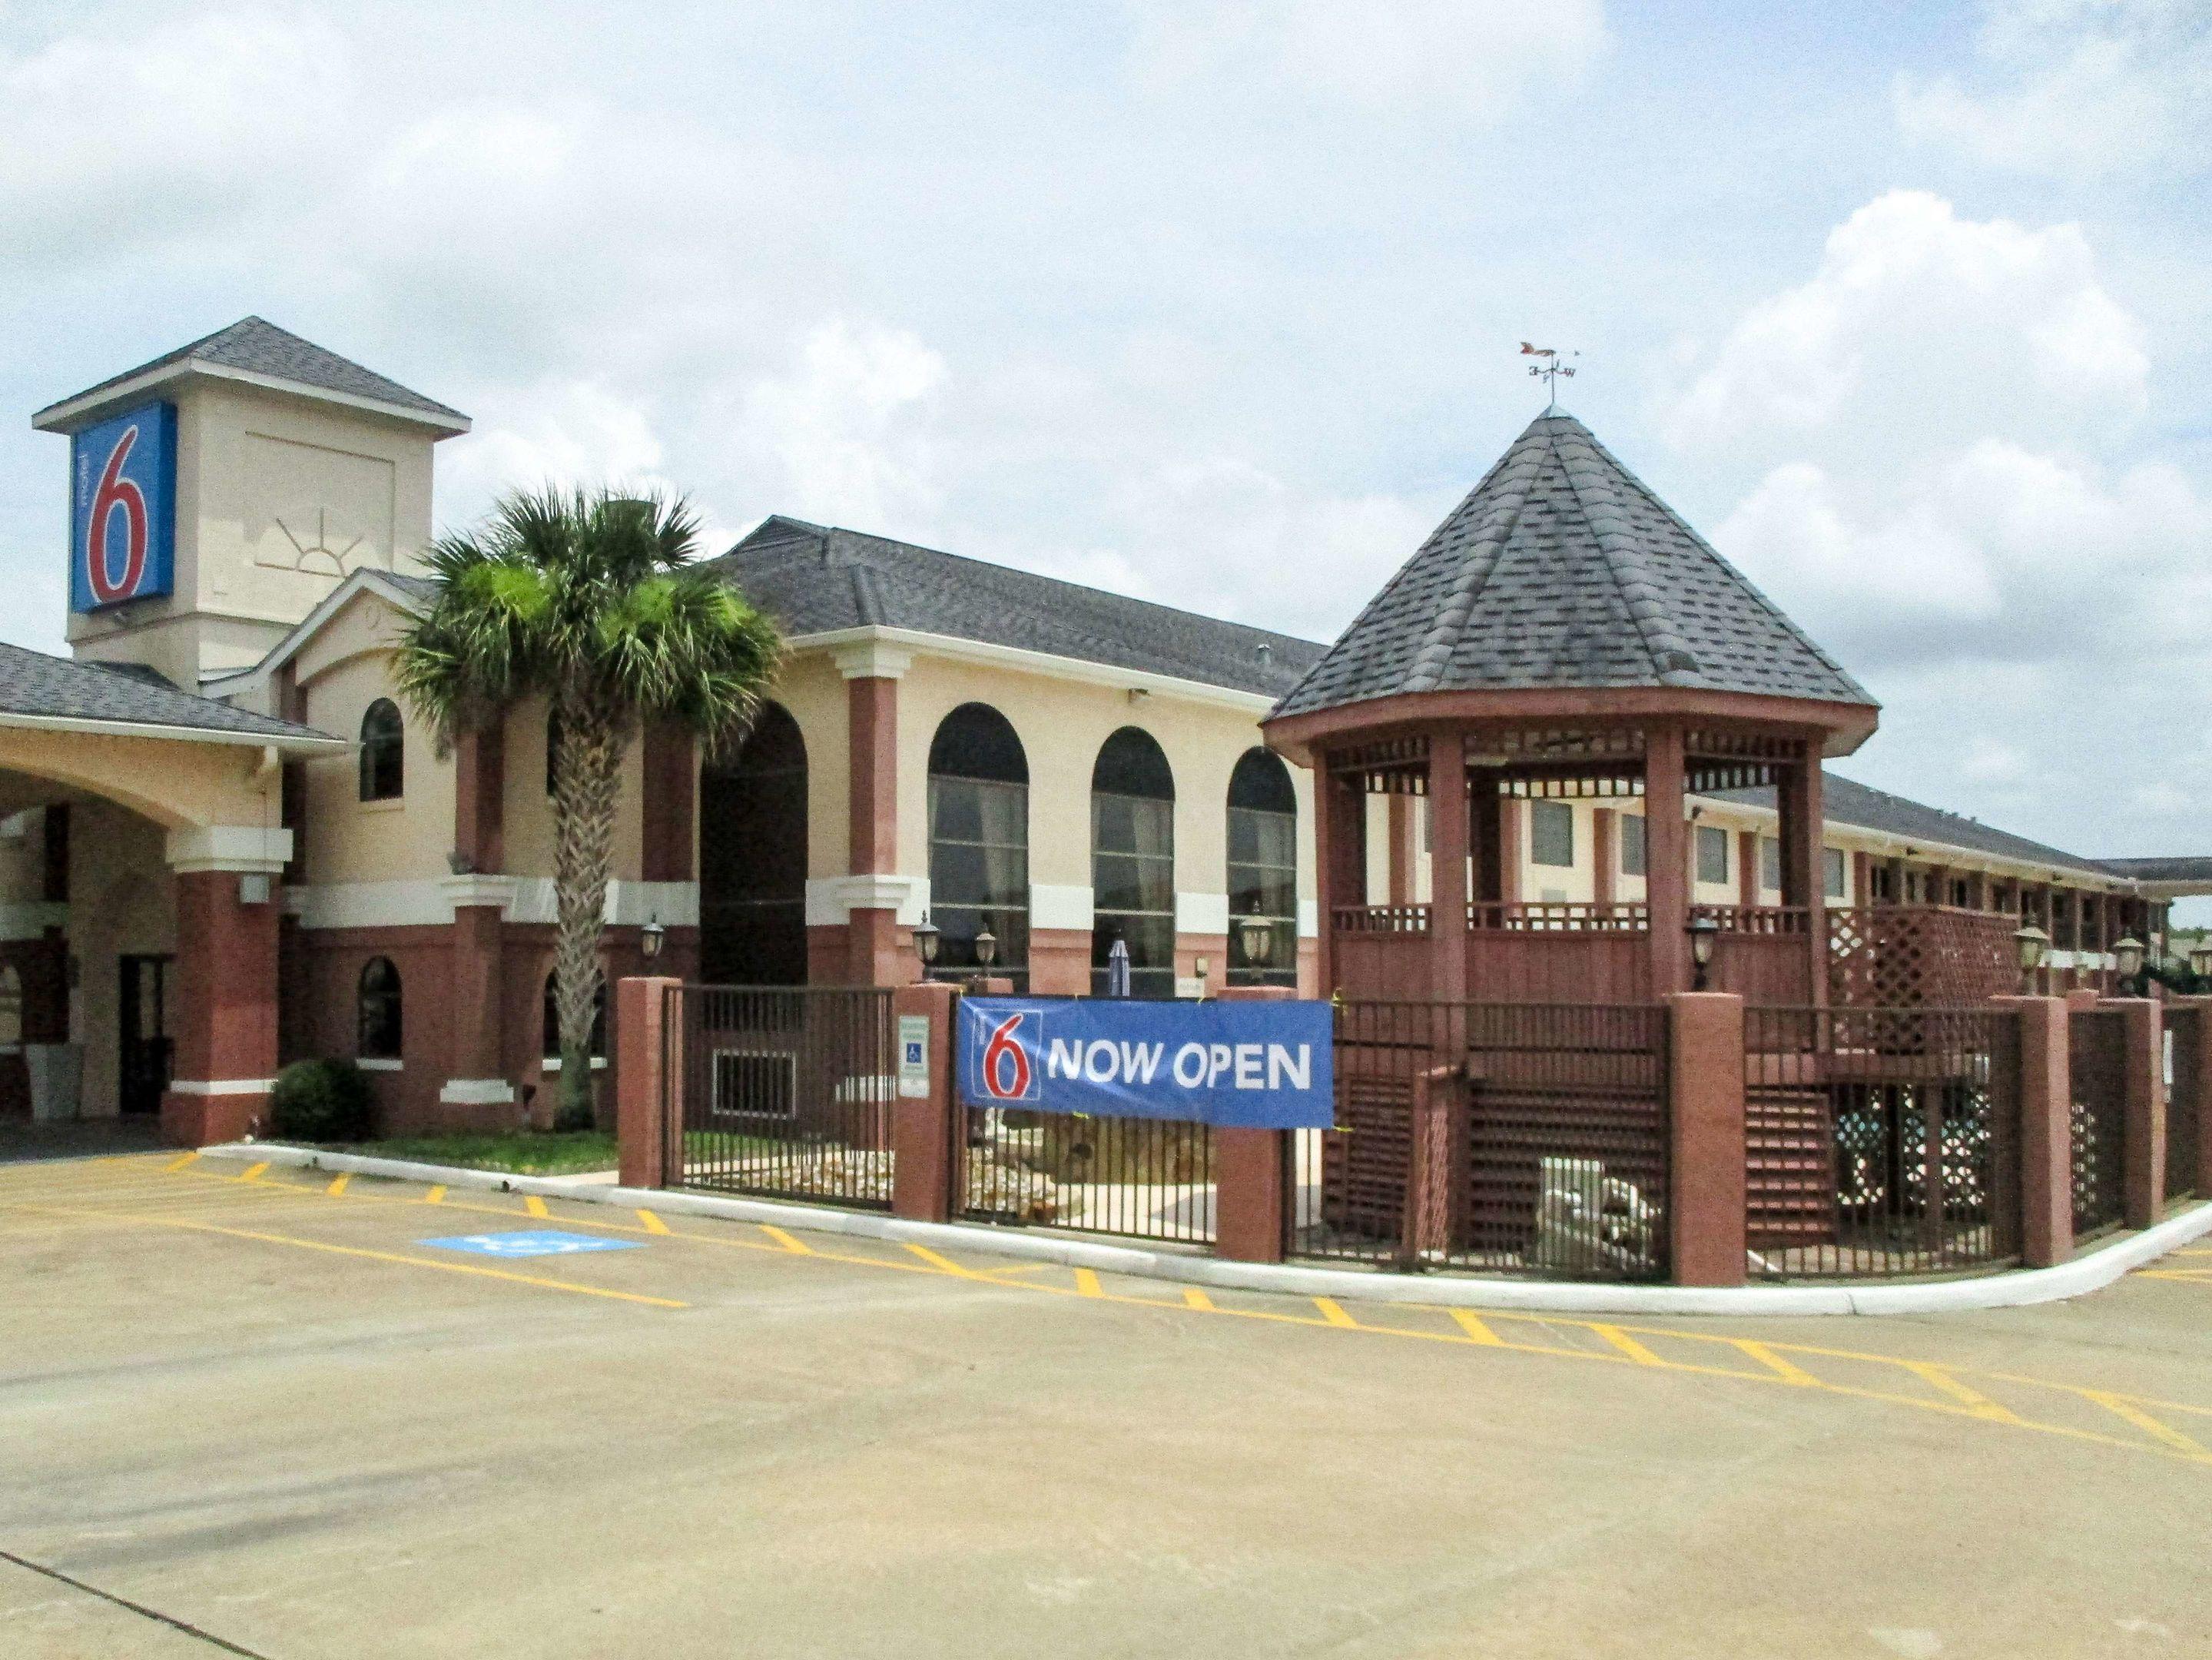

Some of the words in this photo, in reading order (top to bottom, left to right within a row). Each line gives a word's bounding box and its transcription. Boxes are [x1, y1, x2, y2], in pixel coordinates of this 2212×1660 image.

[86, 424, 148, 603] 6
[983, 1013, 1031, 1099] 6
[1047, 1038, 1164, 1084] NOW
[1173, 1042, 1311, 1091] OPEN
